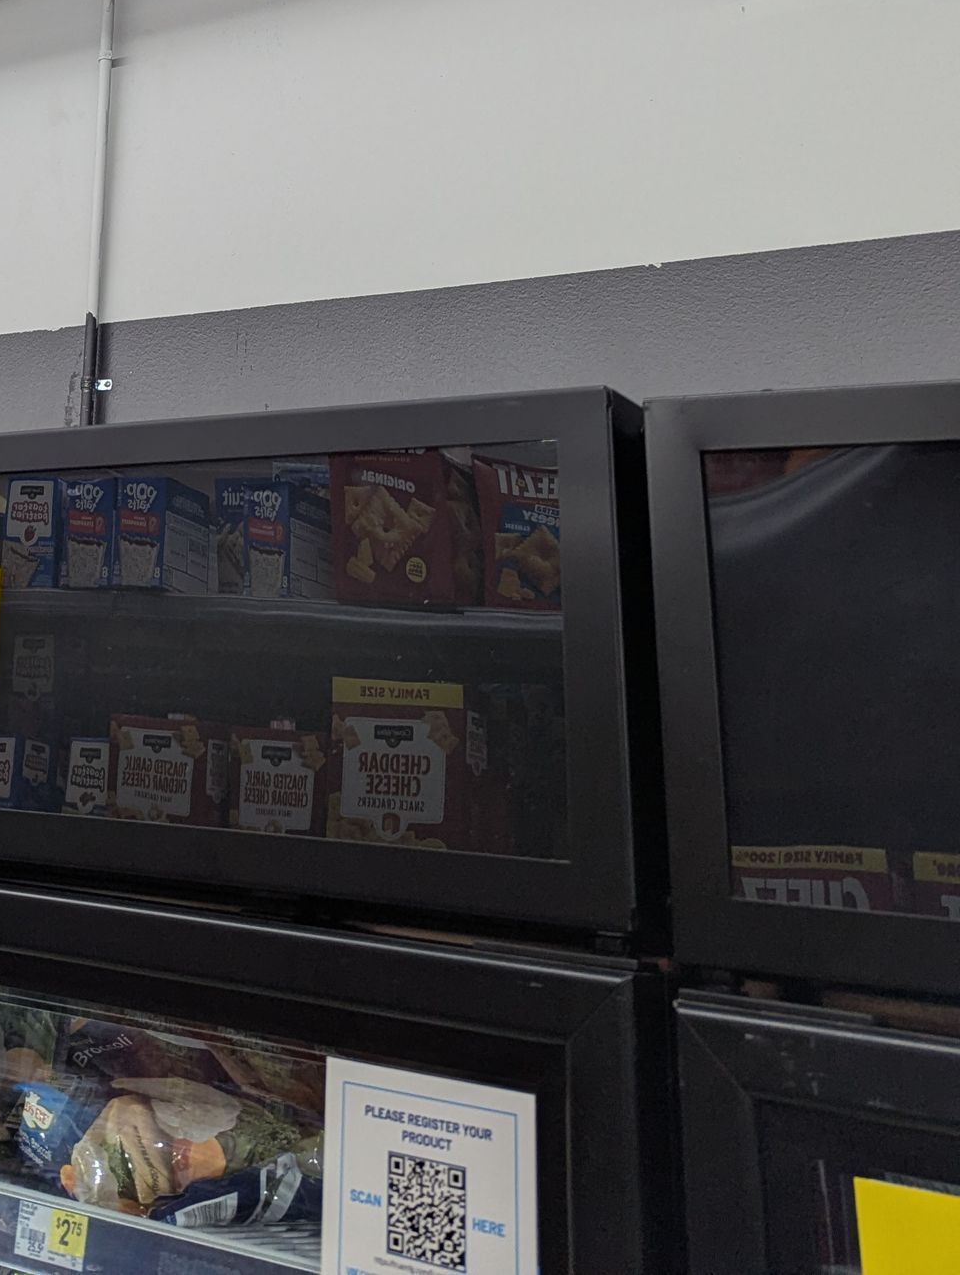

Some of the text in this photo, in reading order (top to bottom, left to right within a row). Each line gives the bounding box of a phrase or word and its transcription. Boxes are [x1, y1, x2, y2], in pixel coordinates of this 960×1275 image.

[72, 1033, 133, 1068] Broccoli
[364, 1104, 493, 1141] PLEASE REGISTER YOUR
[401, 1130, 453, 1151] PRODUCT
[350, 1189, 382, 1207] SCAN
[472, 1218, 506, 1237] HERE
